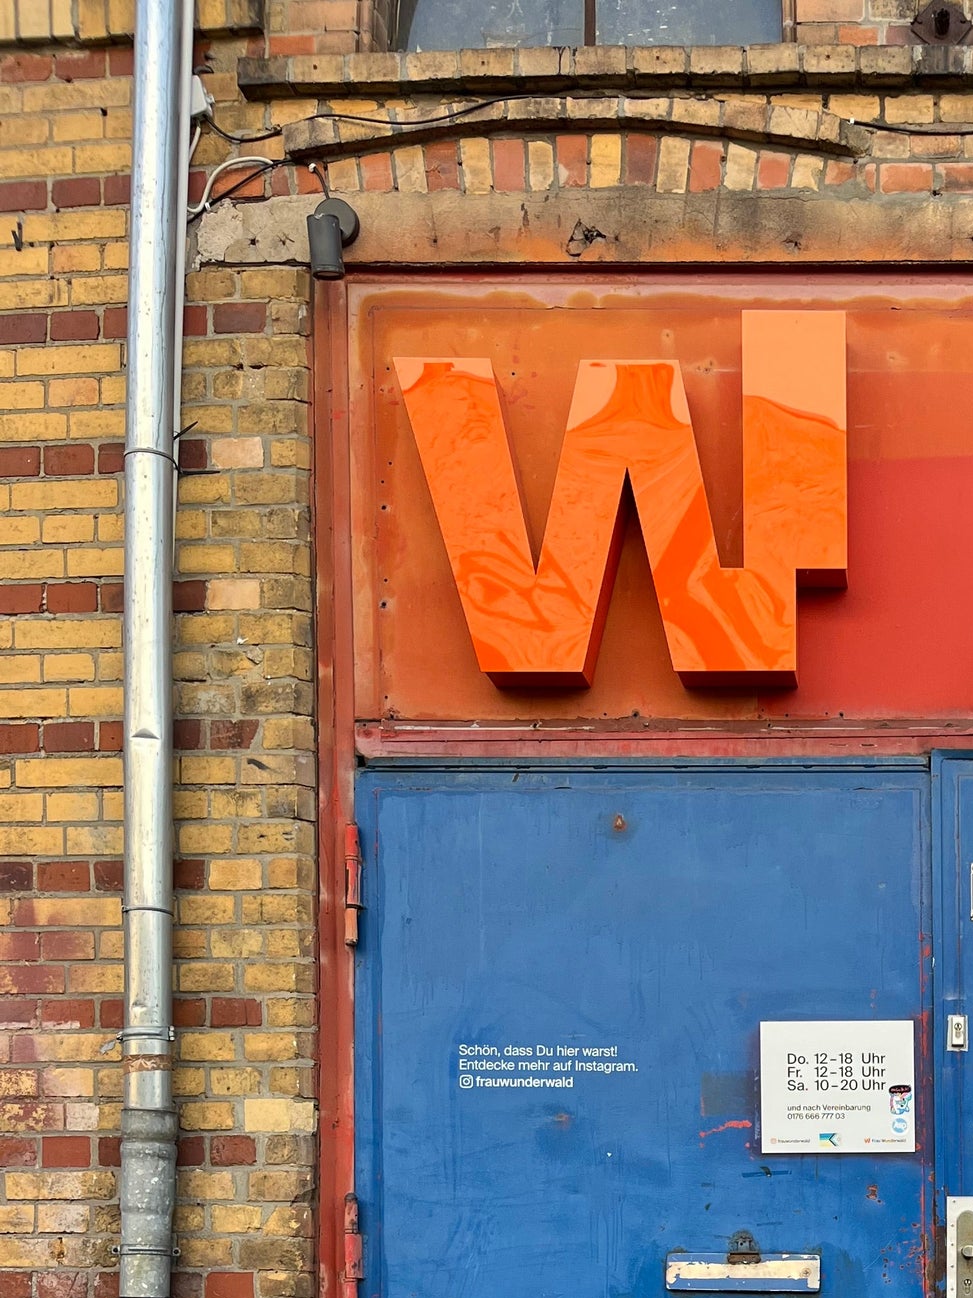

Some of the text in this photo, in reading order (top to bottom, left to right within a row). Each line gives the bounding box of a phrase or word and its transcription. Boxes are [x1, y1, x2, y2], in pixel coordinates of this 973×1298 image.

[458, 1044, 618, 1057] Schön, dass Du hier warst!
[787, 1053, 809, 1065] Do.
[861, 1052, 886, 1065] Uhr
[459, 1058, 639, 1074] Entdecke mehr auf Instagram.
[787, 1066, 803, 1078] Fr.
[861, 1065, 886, 1078] Uhr
[475, 1075, 574, 1088] frauwunderwald
[787, 1079, 808, 1091] Sa.
[861, 1079, 886, 1091] Uhr
[822, 1104, 871, 1112] Vereinbarung
